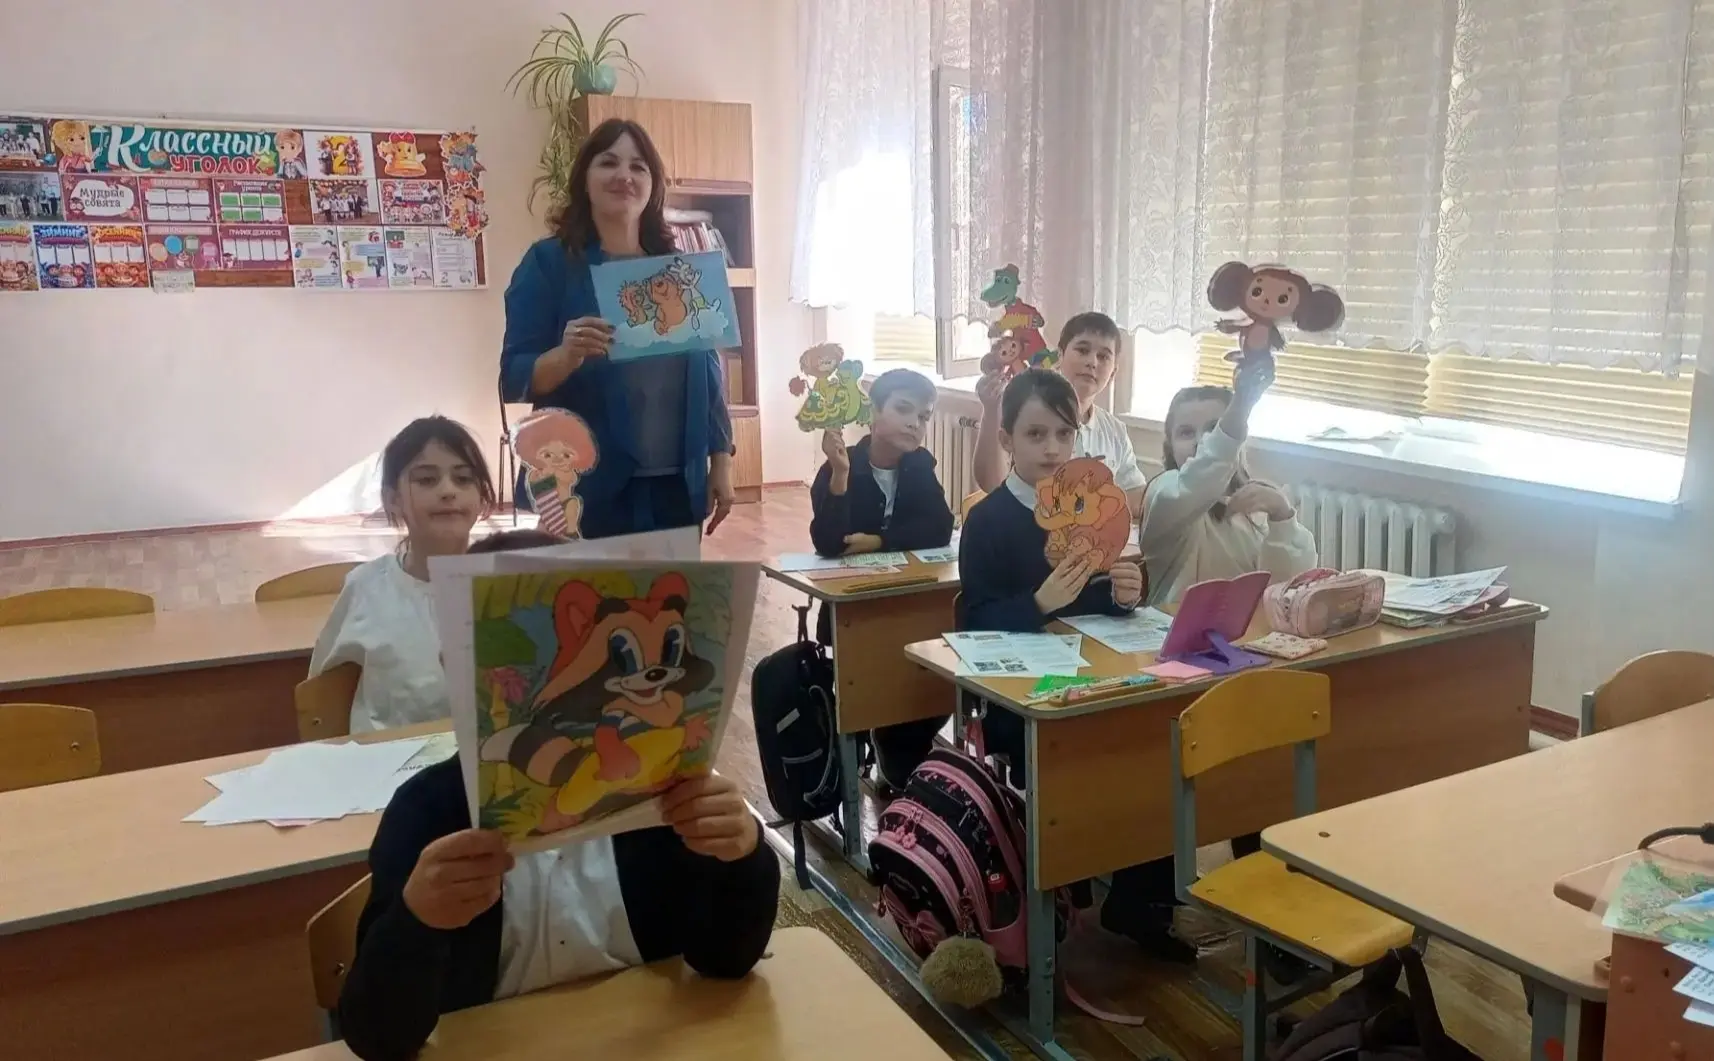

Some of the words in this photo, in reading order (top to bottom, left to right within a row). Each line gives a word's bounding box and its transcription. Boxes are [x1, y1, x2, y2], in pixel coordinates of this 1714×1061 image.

[107, 124, 271, 172] Классный
[169, 153, 261, 175] УГОЛОК
[80, 187, 125, 200] Мудрые
[84, 199, 121, 208] совята
